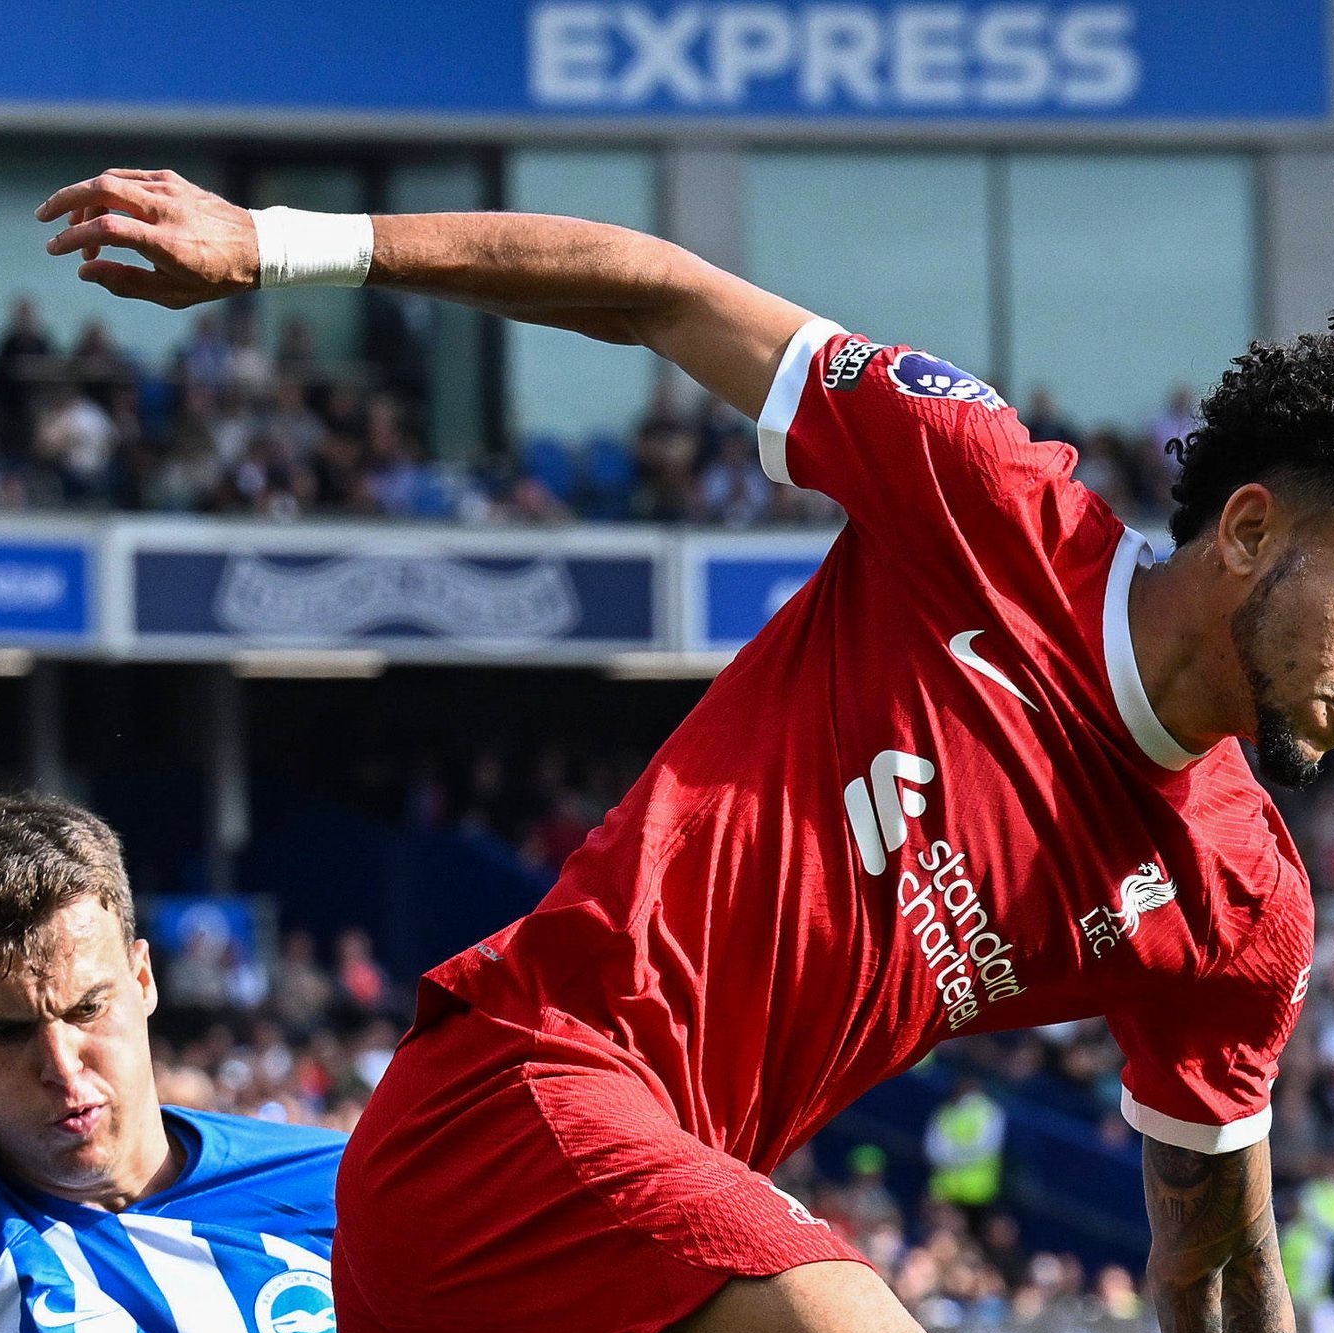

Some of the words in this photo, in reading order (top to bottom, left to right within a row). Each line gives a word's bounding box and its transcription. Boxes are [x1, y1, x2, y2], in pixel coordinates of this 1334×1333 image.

[529, 4, 1141, 110] EXPRESS
[918, 839, 1028, 1003] standard
[1079, 907, 1115, 959] L.F.C.
